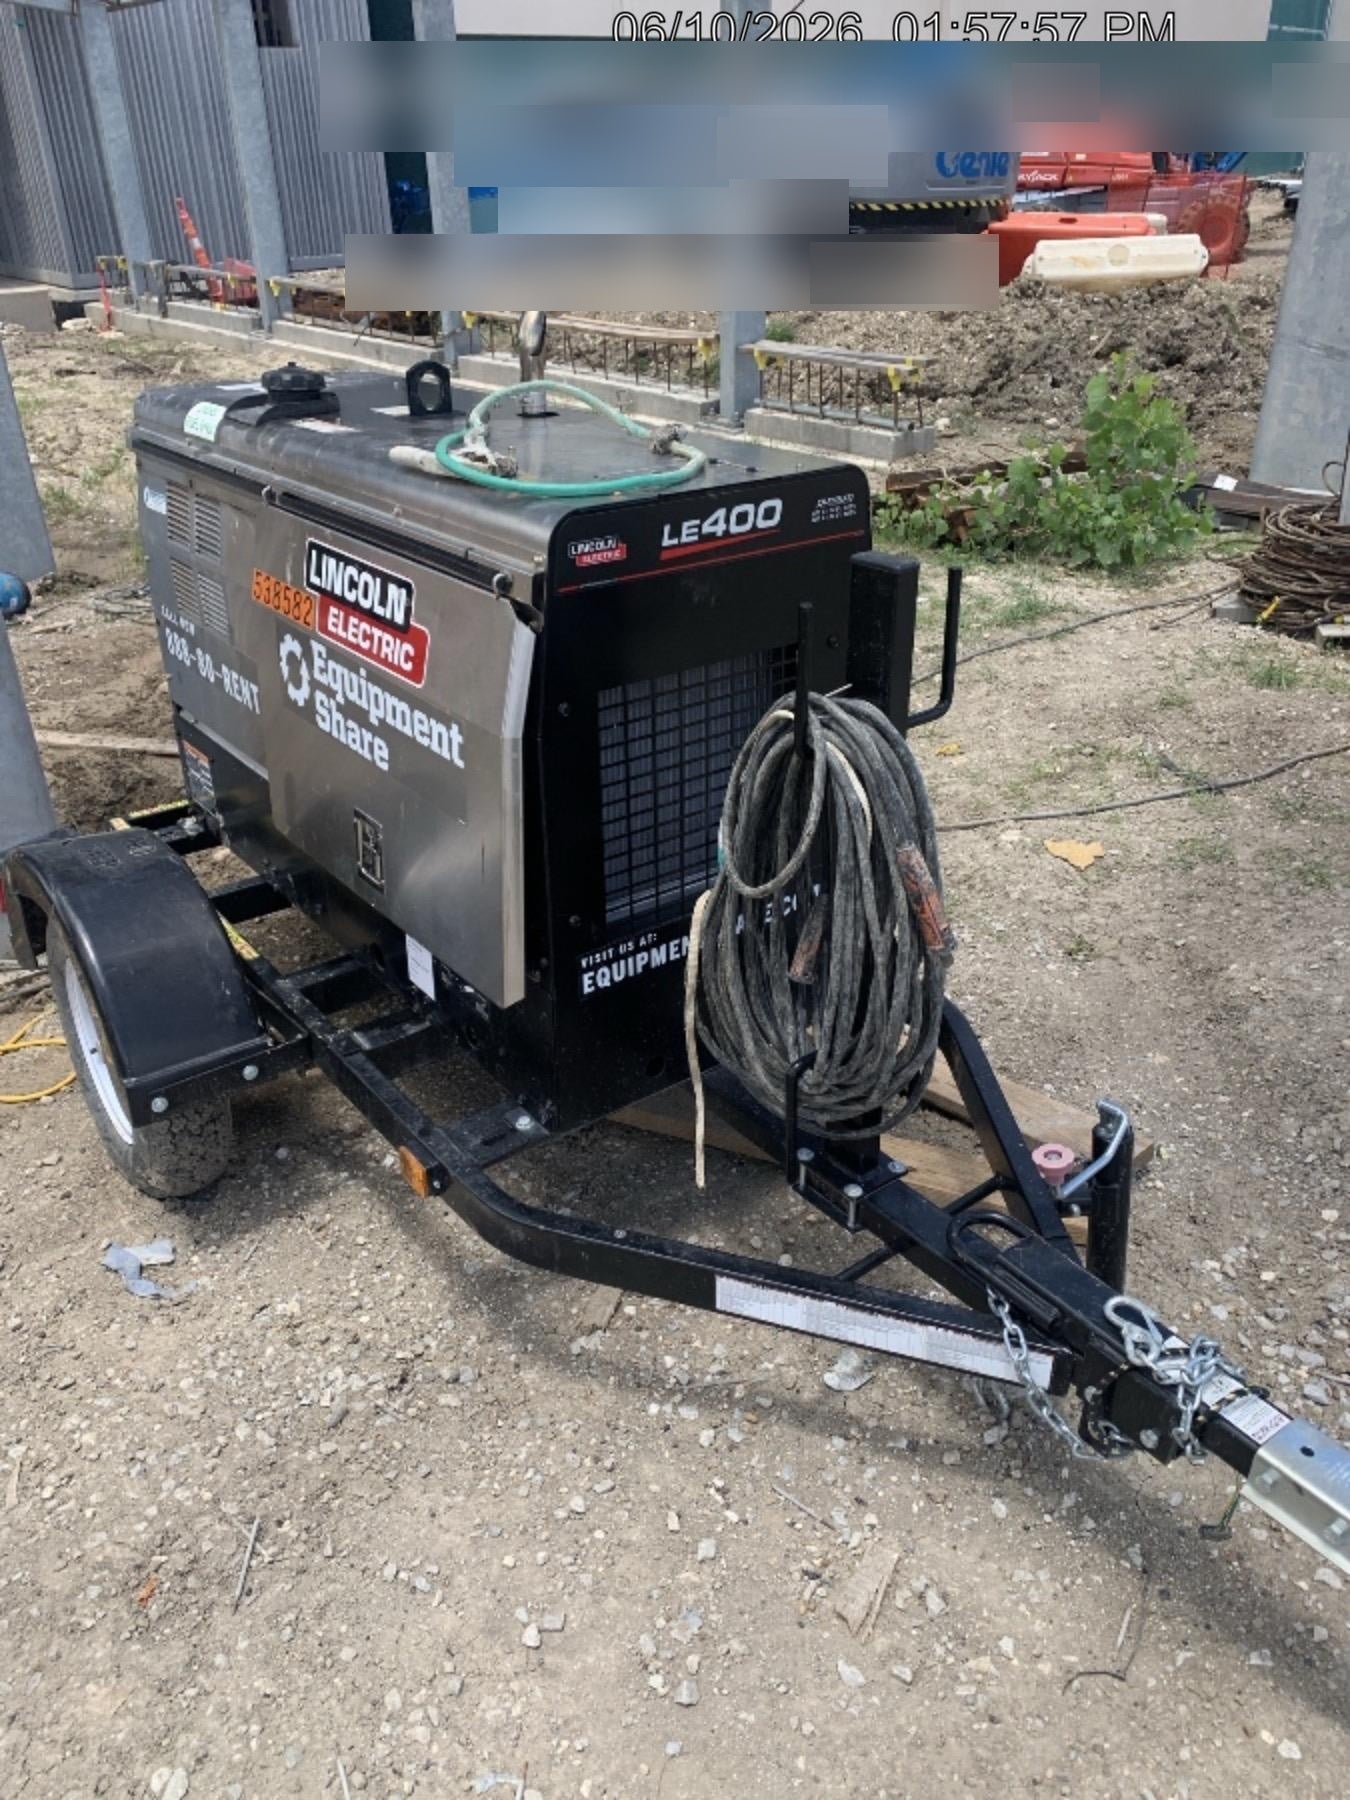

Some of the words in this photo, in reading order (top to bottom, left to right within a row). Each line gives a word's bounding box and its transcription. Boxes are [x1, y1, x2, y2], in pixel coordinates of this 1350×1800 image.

[661, 498, 783, 547] LE400
[253, 571, 313, 626] 538582
[309, 549, 408, 626] LINCOLN
[327, 606, 415, 672] ELECTRIC
[310, 639, 465, 769] Equipment
[315, 689, 389, 771] Share
[581, 948, 614, 968] VISIT
[619, 941, 634, 955] US
[582, 936, 690, 994] EQUIPMEN
